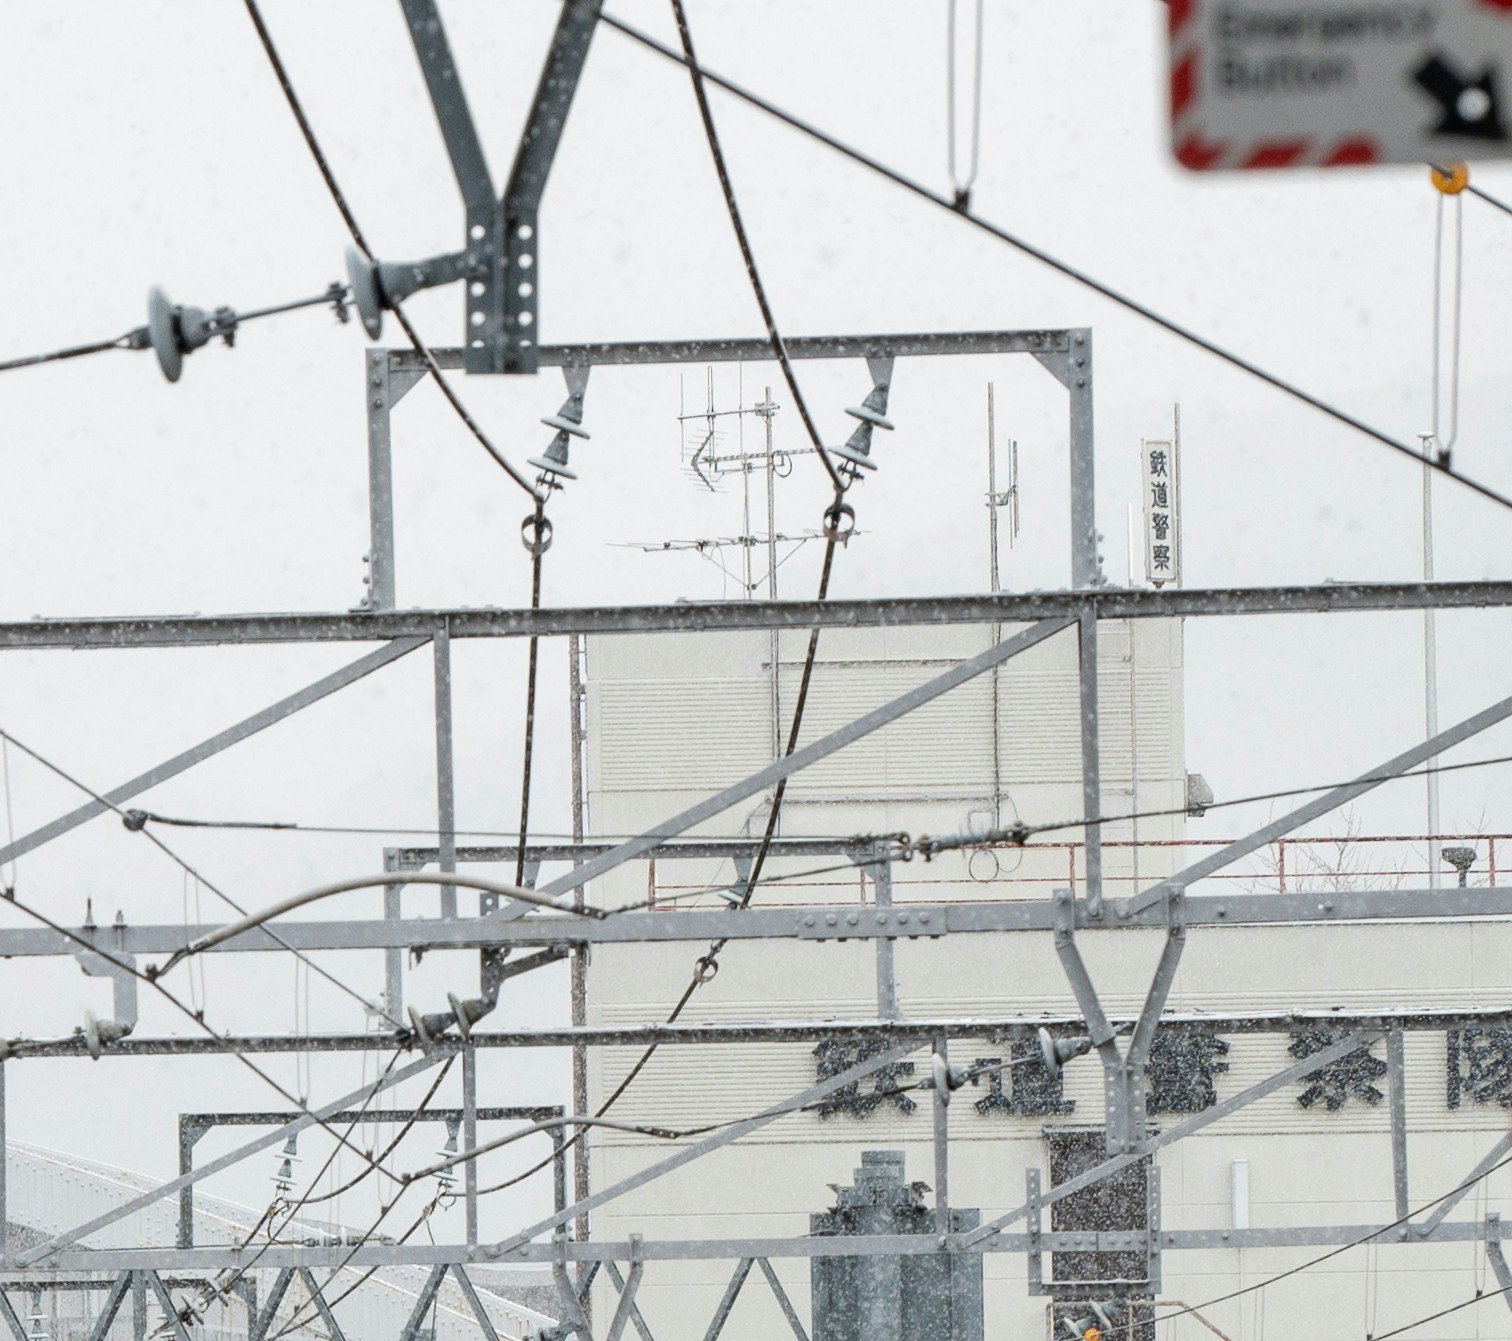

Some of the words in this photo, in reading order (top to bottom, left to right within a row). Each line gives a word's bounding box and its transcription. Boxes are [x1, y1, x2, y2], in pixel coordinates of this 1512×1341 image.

[1214, 6, 1437, 43] Emergency
[1216, 54, 1353, 92] Button
[1149, 449, 1171, 571] 鉄道警察
